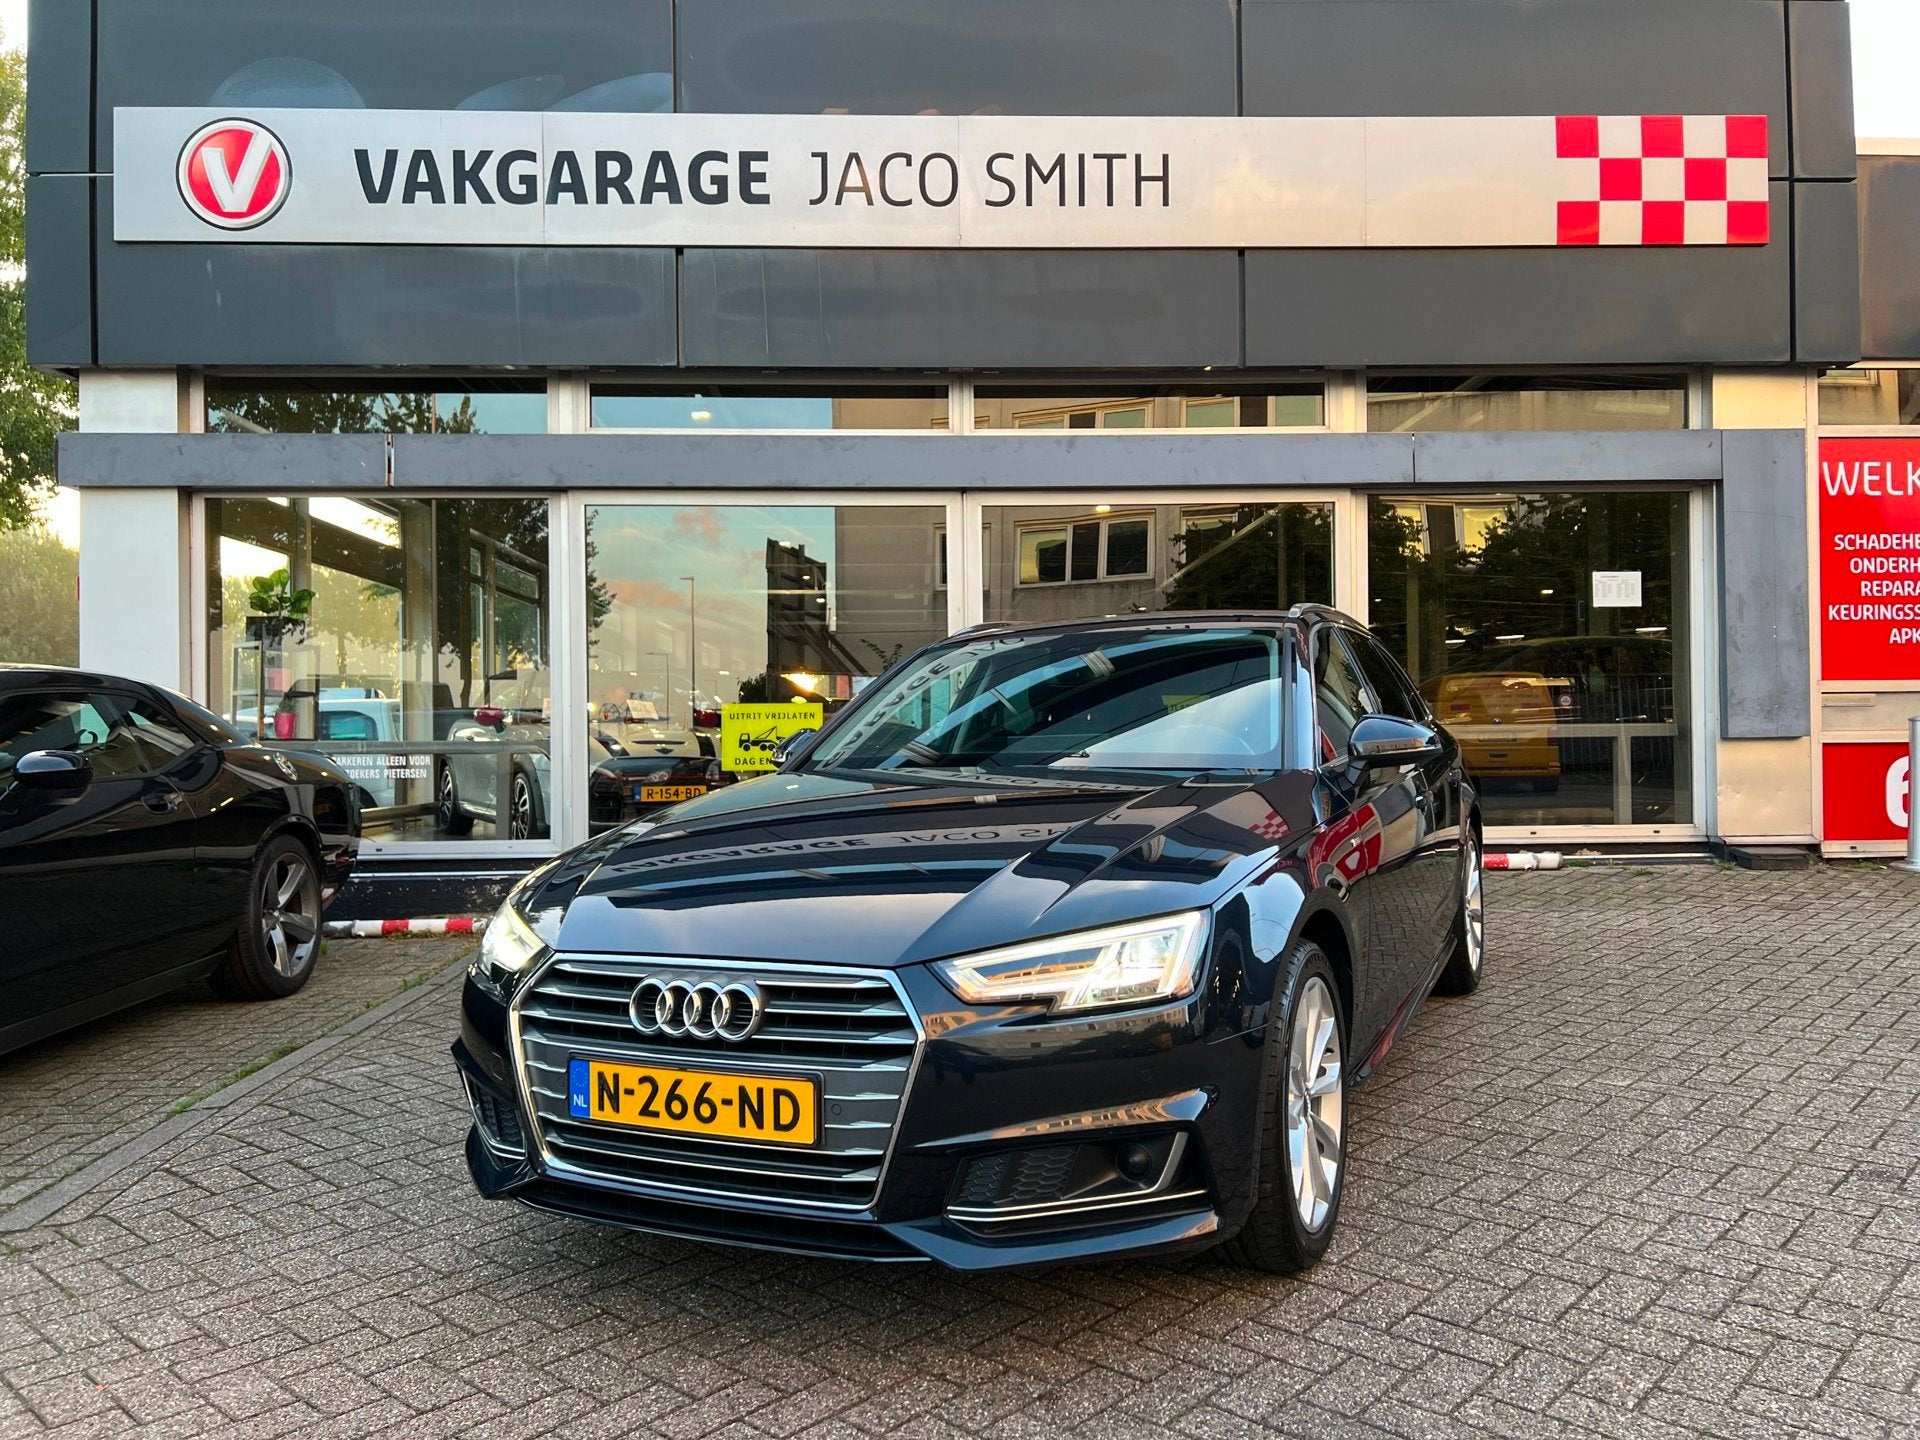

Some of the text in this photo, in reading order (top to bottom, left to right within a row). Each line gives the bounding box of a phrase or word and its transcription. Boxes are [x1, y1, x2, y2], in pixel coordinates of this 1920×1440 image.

[354, 149, 1169, 207] VAKGARAGE JACO SMITH
[1822, 461, 1920, 496] WELK
[1834, 534, 1920, 550] SCHADEHE
[1850, 557, 1920, 573] ONDERH
[1861, 580, 1920, 596] REPARA
[1828, 604, 1920, 621] KEURINGSS
[1889, 628, 1920, 644] APK
[730, 712, 816, 720] UITRIT VRIJLATEN
[376, 756, 406, 766] ALLEEN
[409, 756, 431, 766] VOOR
[735, 758, 755, 766] DAG
[384, 768, 427, 779] PIETERSEN
[573, 1093, 588, 1108] NL
[597, 1071, 801, 1132] N-266-ND
